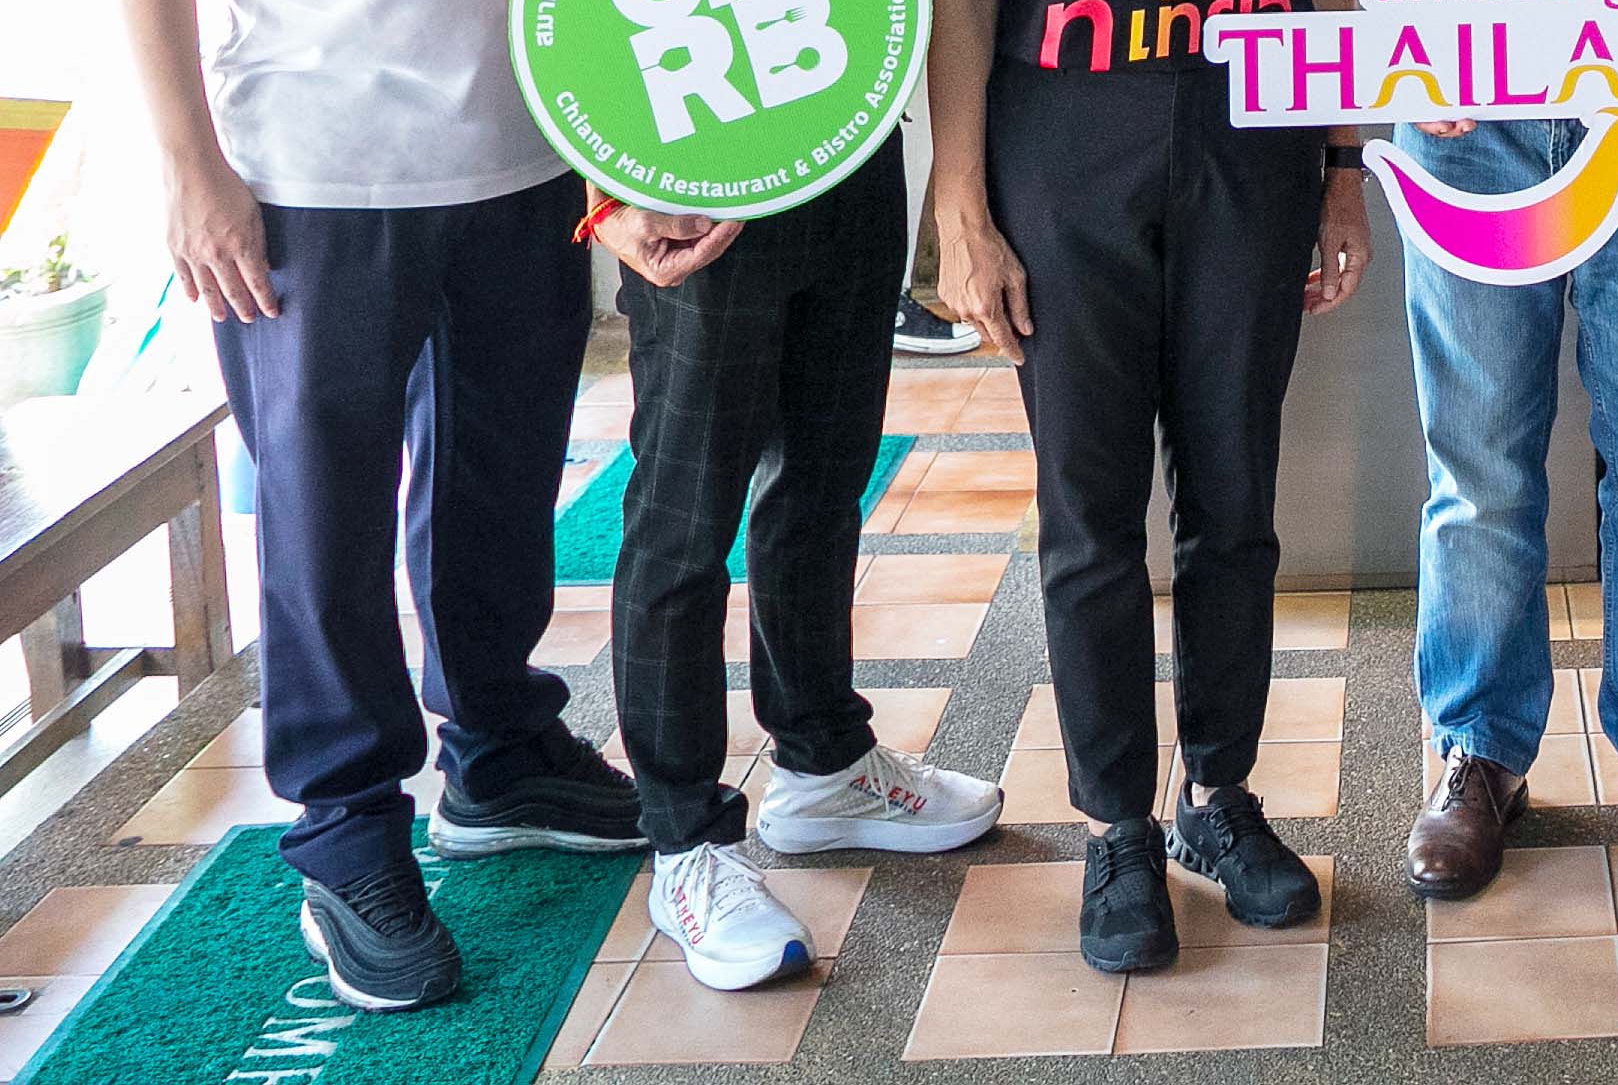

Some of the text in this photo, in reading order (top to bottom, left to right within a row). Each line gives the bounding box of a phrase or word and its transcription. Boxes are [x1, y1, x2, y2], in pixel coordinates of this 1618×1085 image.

[555, 91, 616, 163] Chiang
[615, 152, 657, 184] Mai
[658, 168, 790, 199] Restaurant
[794, 159, 811, 177] &
[811, 111, 870, 166] Bistro
